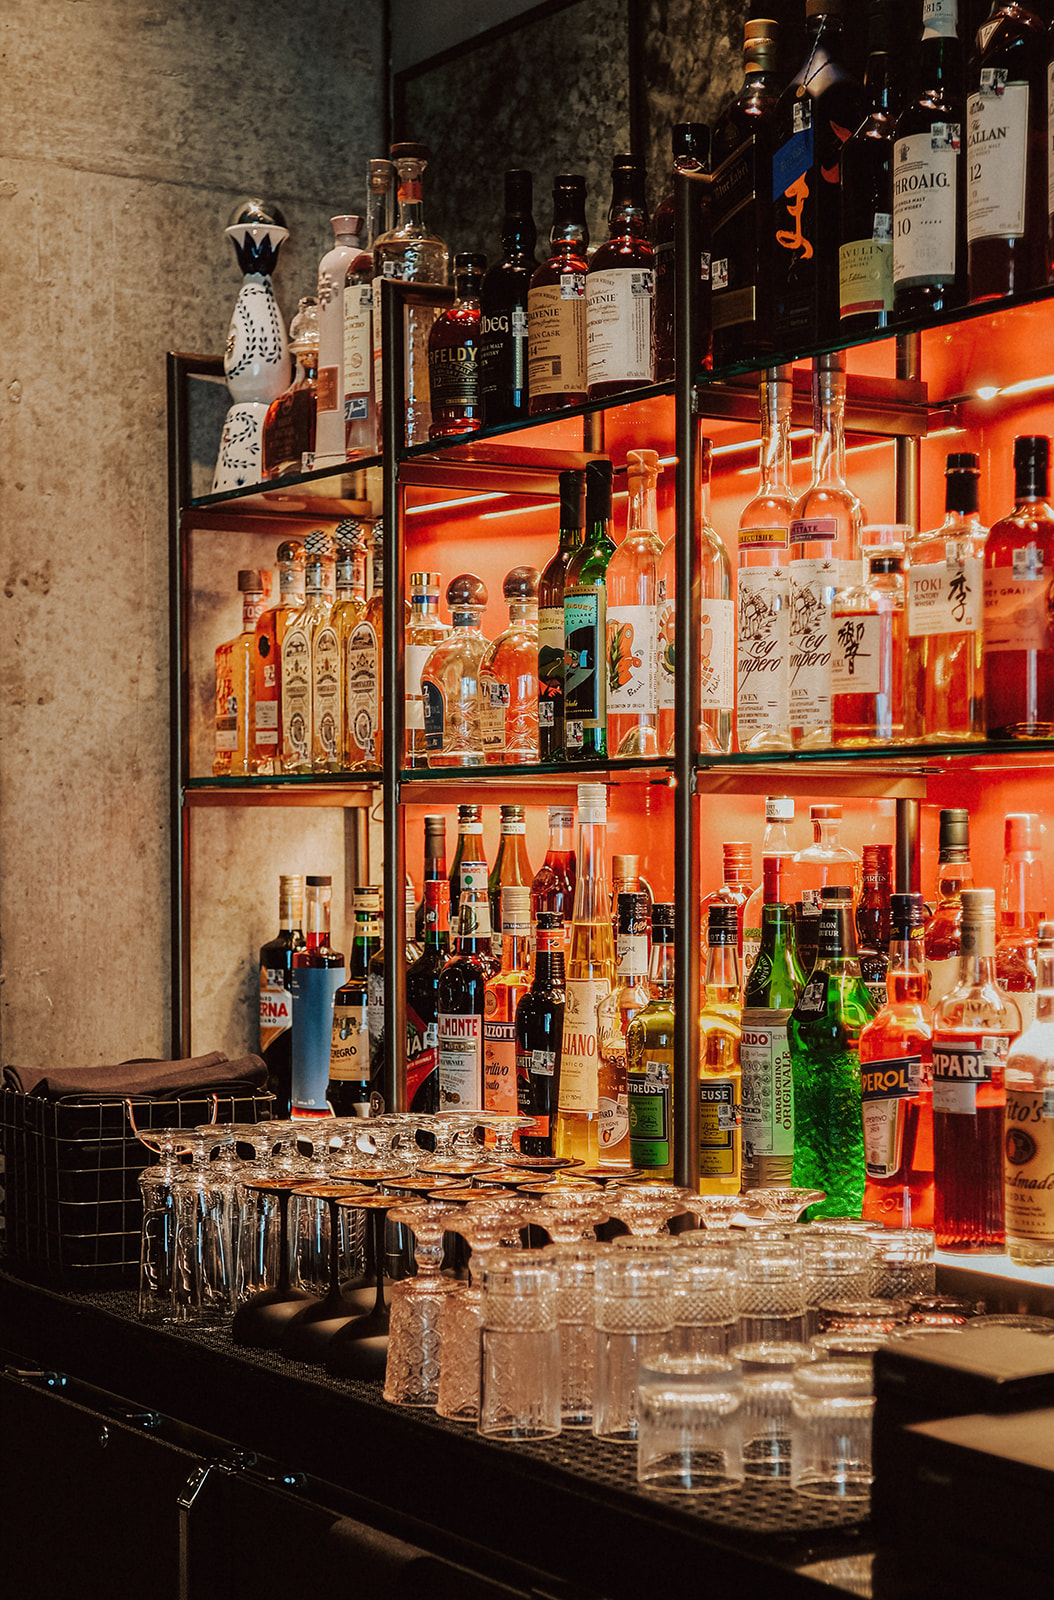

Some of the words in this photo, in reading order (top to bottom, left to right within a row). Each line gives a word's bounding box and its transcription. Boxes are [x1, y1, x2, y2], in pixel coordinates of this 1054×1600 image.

[970, 163, 982, 182] 12
[897, 218, 911, 237] 10
[541, 329, 561, 337] CASK
[914, 578, 942, 592] TOKI
[914, 592, 940, 600] SUNTORY
[750, 640, 778, 655] rey
[800, 634, 828, 649] rey
[701, 1091, 729, 1100] EUSE
[782, 1051, 791, 1130] ORIGINALE
